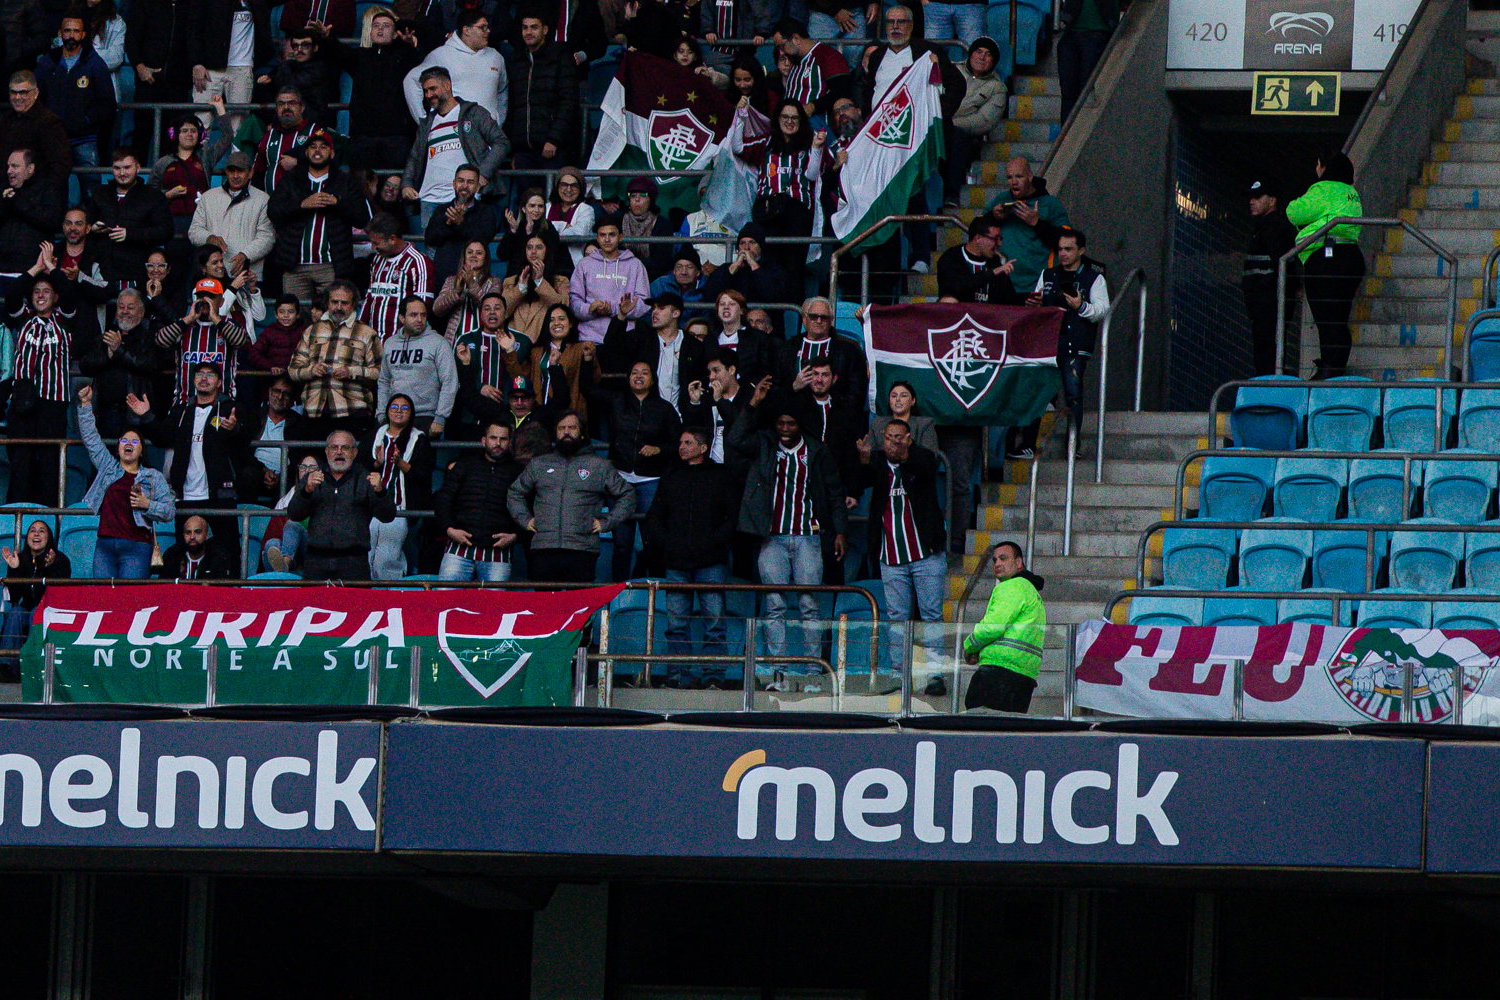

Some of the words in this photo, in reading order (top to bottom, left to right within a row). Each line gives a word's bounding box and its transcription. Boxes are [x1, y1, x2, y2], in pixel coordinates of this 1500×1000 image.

[1185, 22, 1228, 42] 420
[1274, 43, 1322, 55] ARENA
[183, 352, 224, 363] CAIXA
[390, 349, 424, 364] UNB
[273, 648, 293, 671] A
[323, 647, 400, 671] SUL
[737, 741, 1180, 846] melnick
